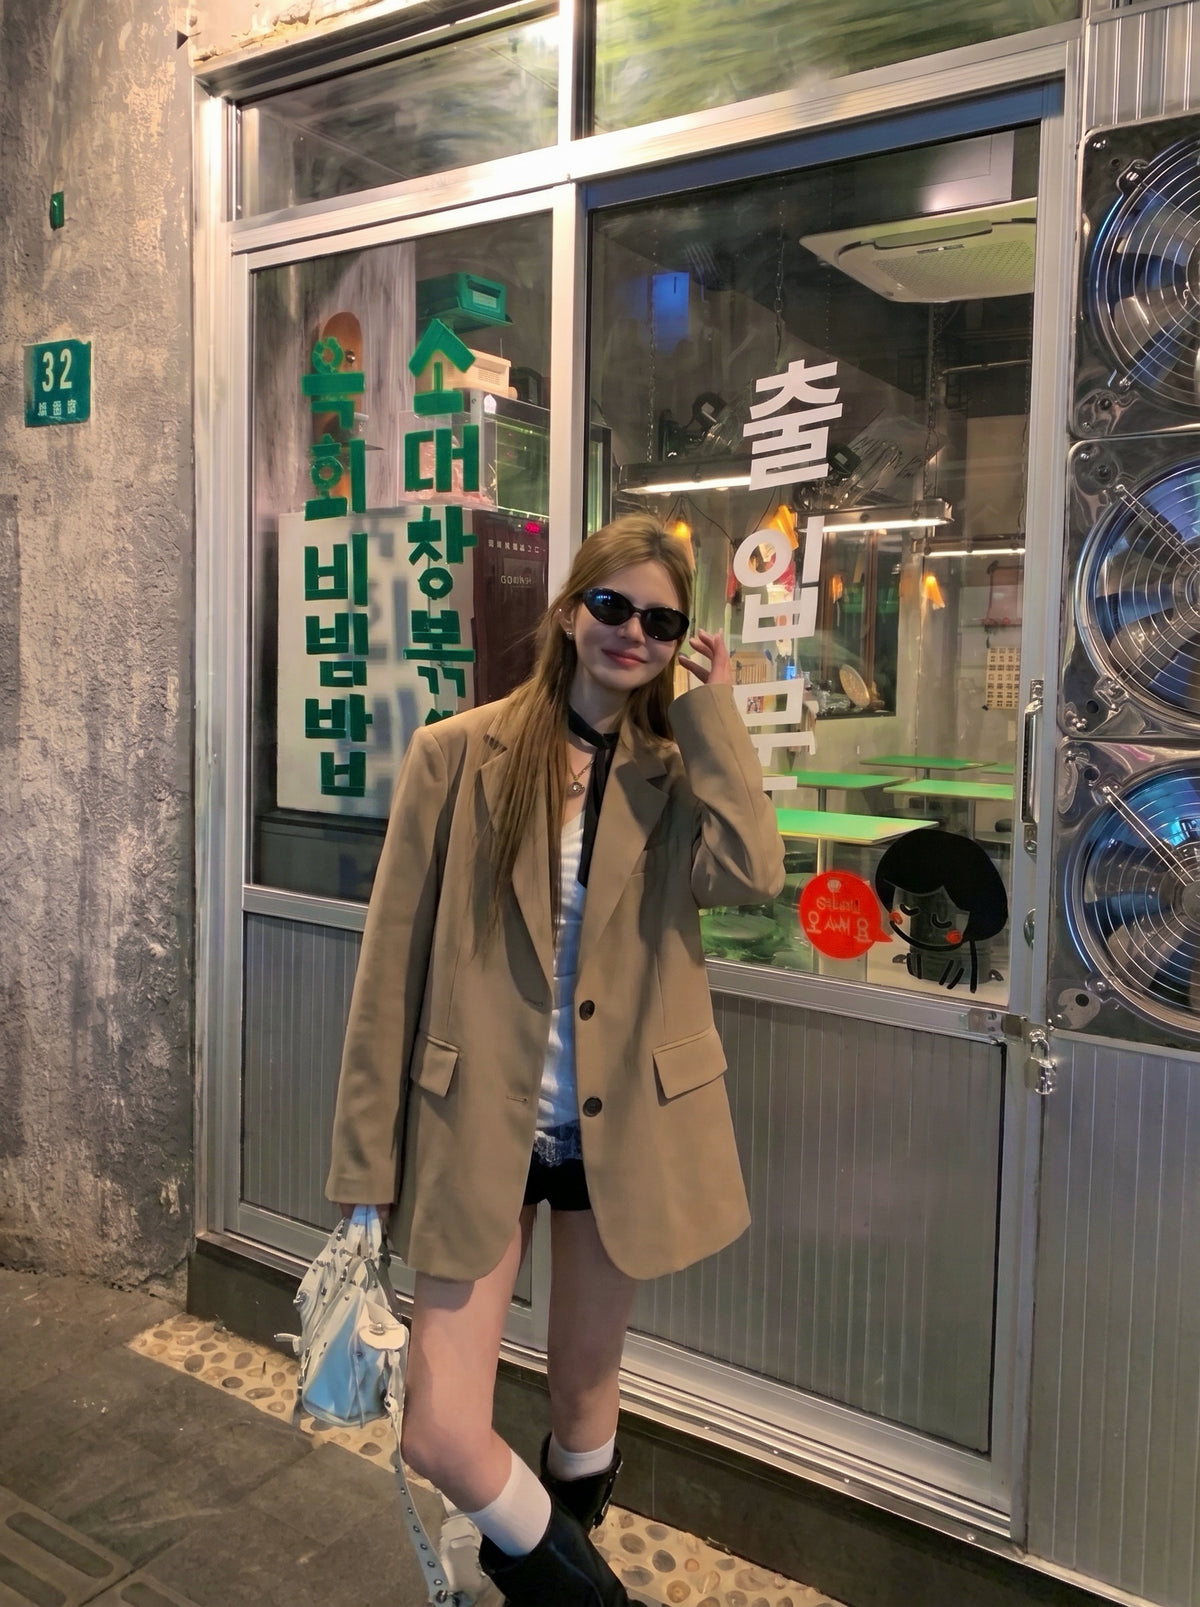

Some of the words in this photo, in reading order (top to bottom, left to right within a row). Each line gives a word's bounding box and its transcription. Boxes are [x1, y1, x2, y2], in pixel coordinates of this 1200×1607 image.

[42, 348, 72, 392] 32
[302, 336, 373, 797] 육회비빔밥
[403, 318, 479, 726] 소대창볶
